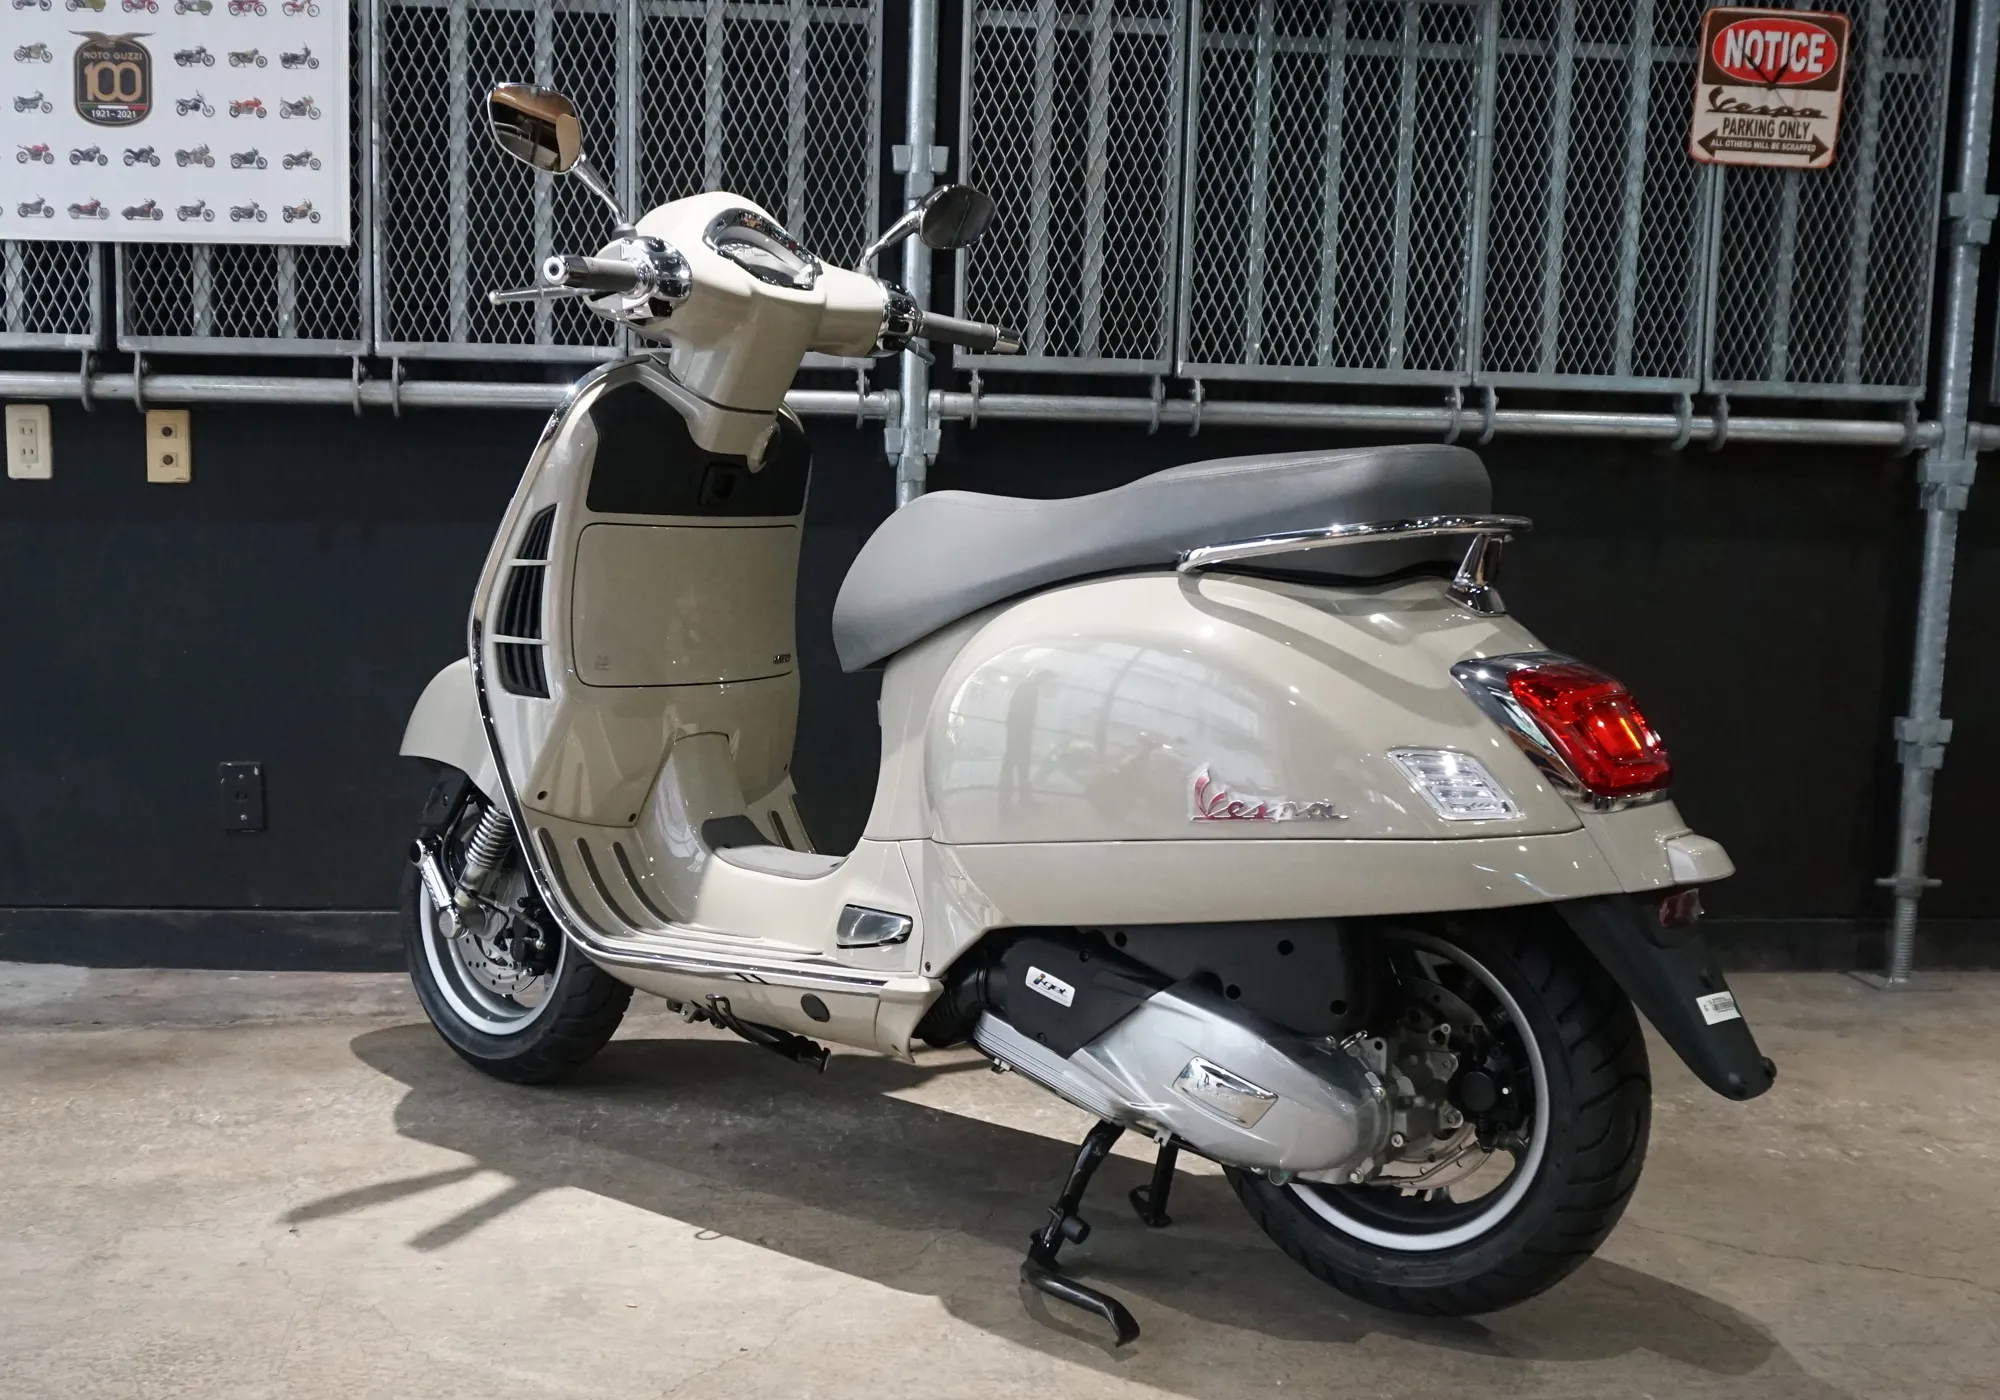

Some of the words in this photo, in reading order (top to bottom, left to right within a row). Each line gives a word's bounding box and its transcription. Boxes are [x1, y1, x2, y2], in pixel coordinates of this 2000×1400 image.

[82, 51, 110, 60] MOTO
[113, 51, 143, 60] GUZZI
[1723, 28, 1827, 73] NOTICE
[84, 61, 142, 102] 100
[1705, 85, 1829, 119] Vespa
[1710, 138, 1723, 147] ALL
[1725, 140, 1752, 148] OTHERS
[1753, 141, 1770, 149] WILL
[1771, 142, 1780, 150] BE
[1781, 143, 1817, 152] SCRAPPED
[1722, 117, 1776, 138] PARKING
[1778, 119, 1812, 140] ONLY
[1190, 768, 1348, 823] Vespa
